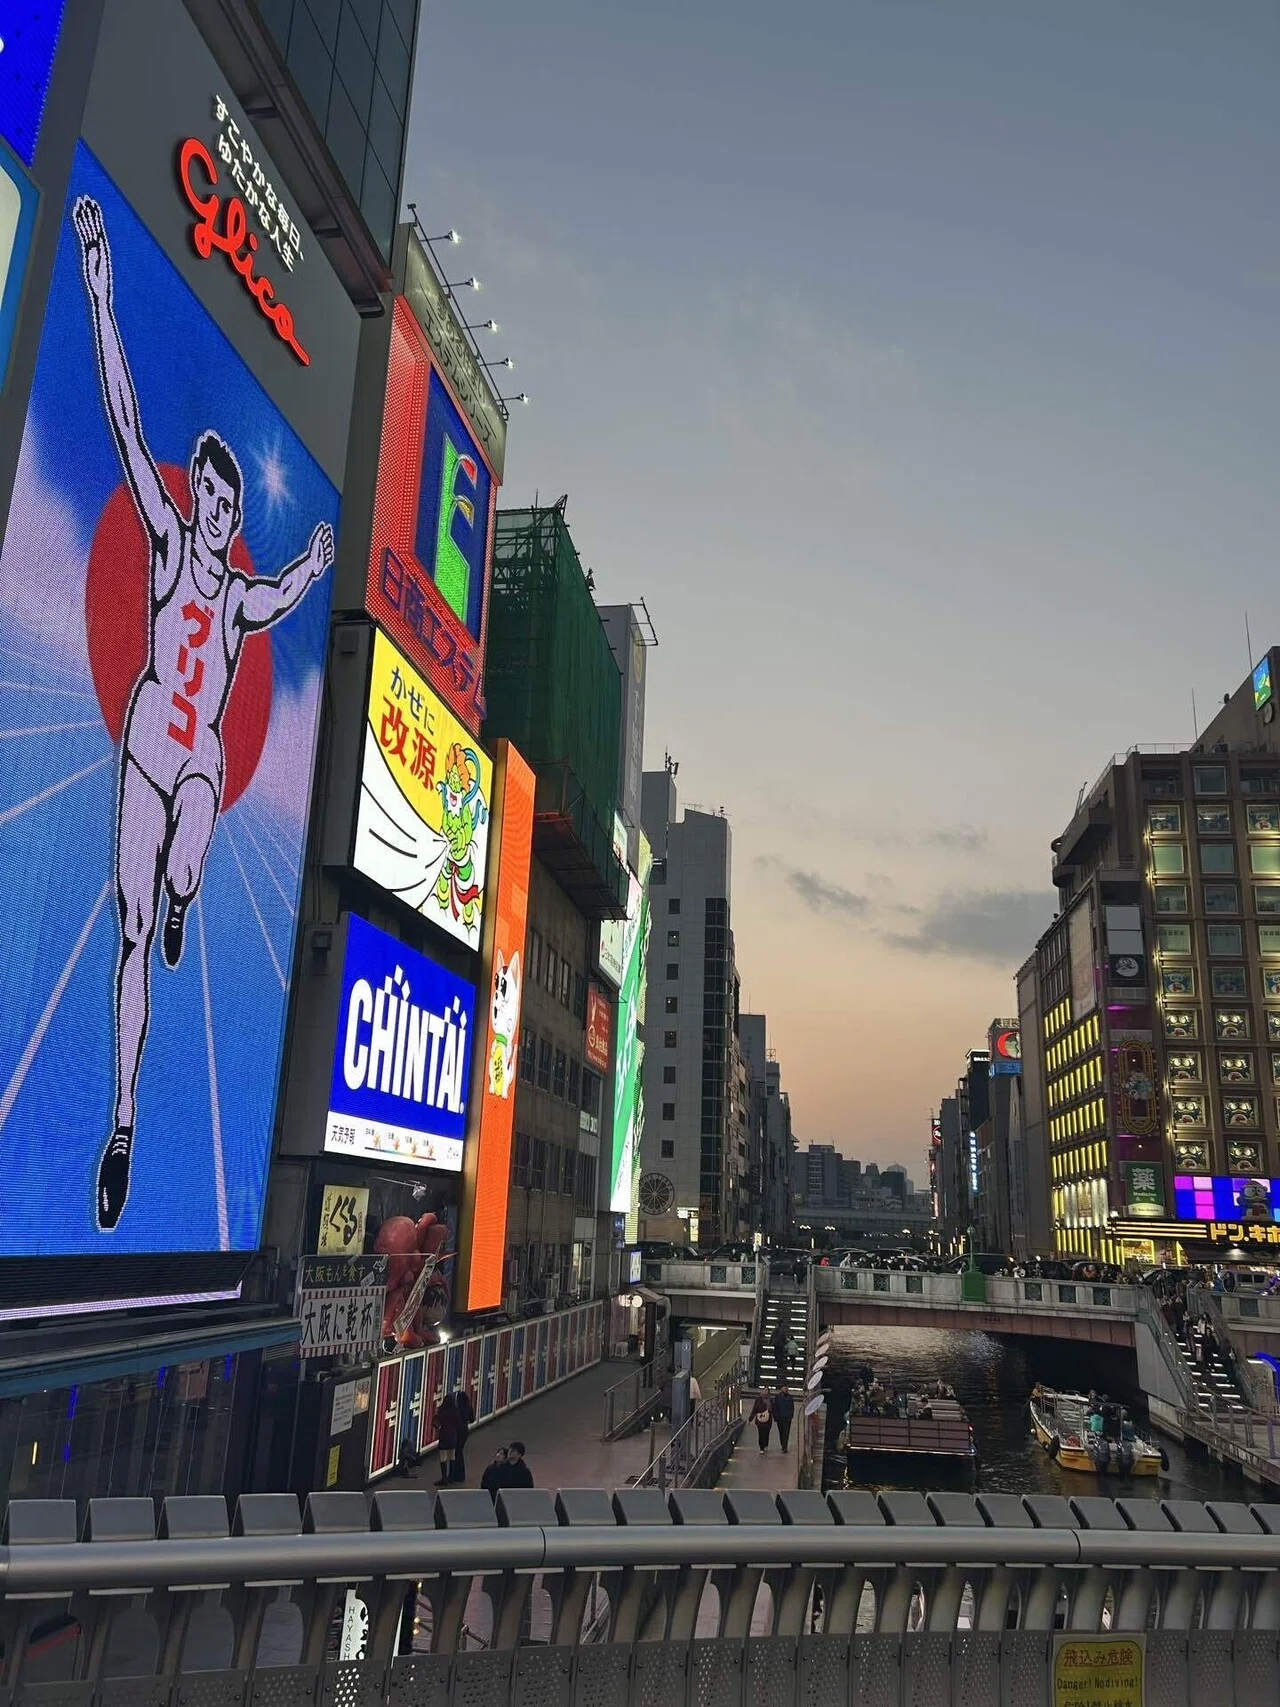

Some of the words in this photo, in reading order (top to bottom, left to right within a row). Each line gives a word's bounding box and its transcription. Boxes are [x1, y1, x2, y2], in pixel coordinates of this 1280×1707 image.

[180, 137, 312, 367] Glico
[216, 94, 304, 261] すこやかな毎日、
[218, 134, 293, 273] ゆたかな人生
[166, 599, 216, 752] グリコ
[380, 693, 438, 791] 改源
[343, 964, 466, 1114] CHINTAI
[1063, 1647, 1135, 1666] 飛込み危険
